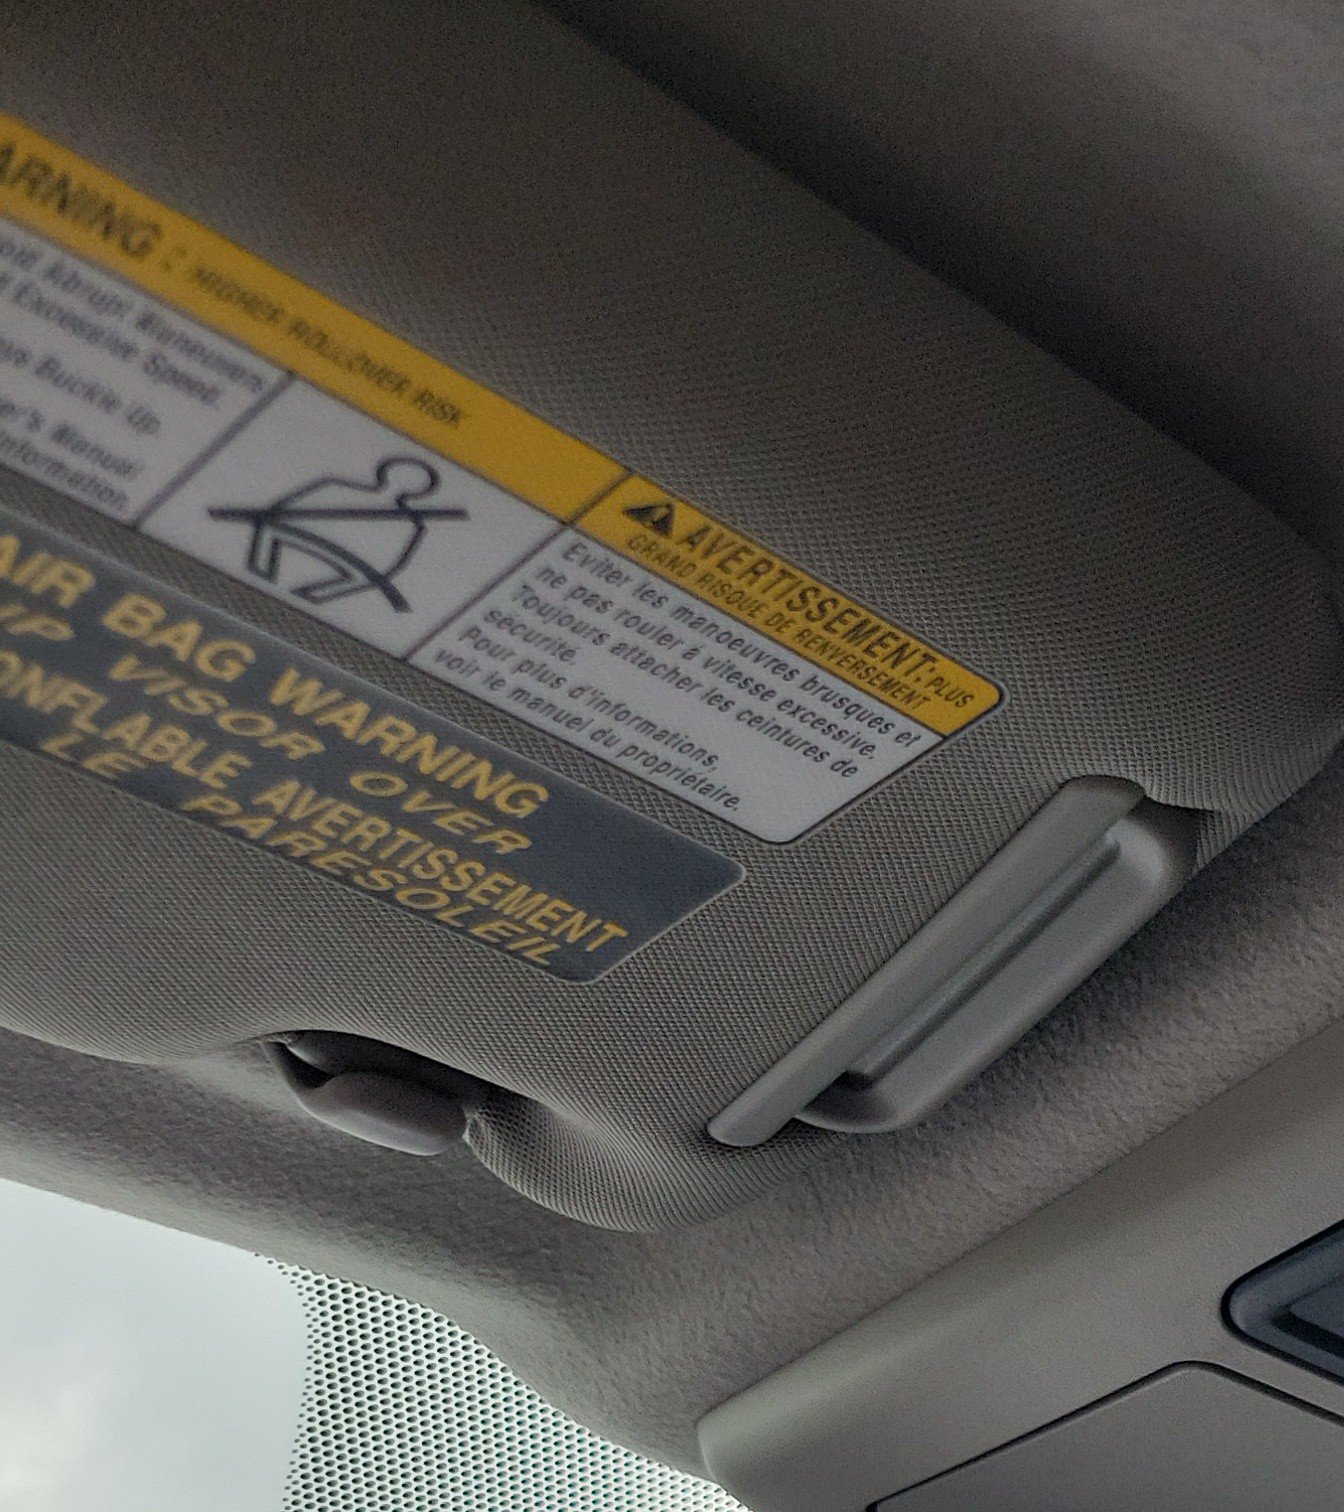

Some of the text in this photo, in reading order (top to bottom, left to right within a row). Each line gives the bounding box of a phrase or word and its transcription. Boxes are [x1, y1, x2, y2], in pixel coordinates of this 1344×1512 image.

[413, 389, 461, 424] RISK
[103, 594, 254, 681] BAG
[271, 668, 547, 817] WARNING
[435, 650, 480, 675] voir
[482, 672, 505, 690] le
[508, 687, 588, 731] manuel
[589, 729, 619, 747] du
[459, 624, 516, 662] Pour
[512, 659, 566, 689] plus
[513, 583, 858, 777] Toujours attacher les ceintures de
[537, 567, 566, 588] ne
[565, 585, 613, 613] pas
[614, 609, 689, 649] rouler
[703, 657, 776, 701] vitesse
[777, 699, 877, 759] excessive.
[627, 535, 932, 706] GRAND RISQUE DE RENVERSEMENT
[633, 582, 668, 608] les
[672, 606, 799, 681] manoeuvres
[799, 675, 895, 734] brusques
[894, 731, 921, 747] et
[925, 676, 974, 707] PLUS
[110, 655, 324, 760] VISOR
[349, 772, 530, 854] OVER
[41, 728, 566, 964] LE PARESOLEIL
[253, 779, 627, 951] AVERTISSEMENT
